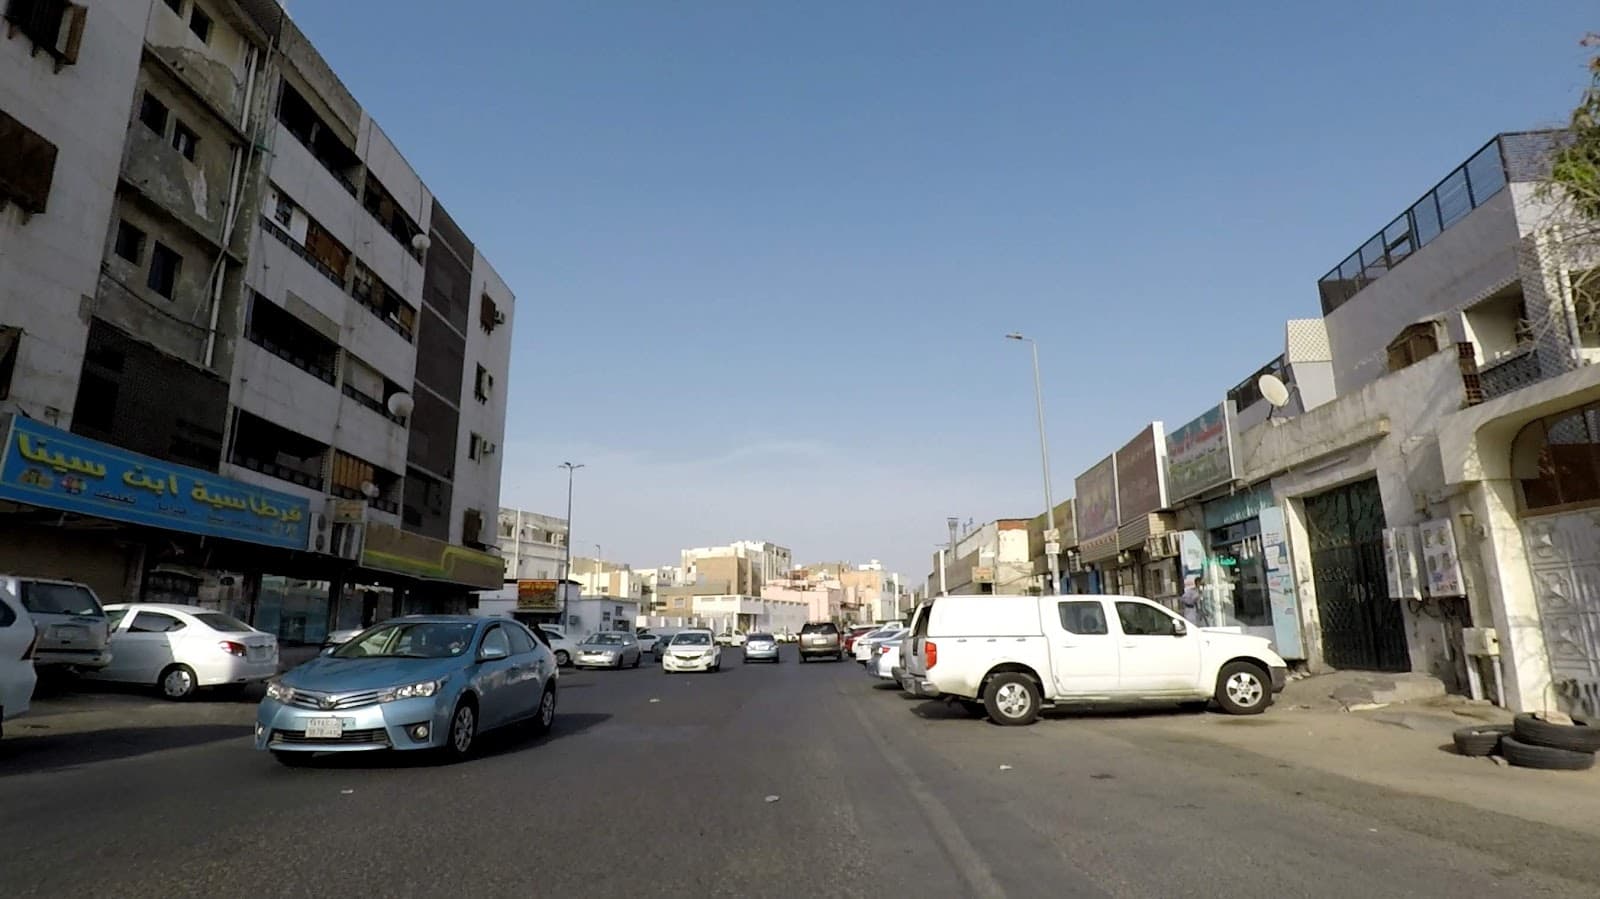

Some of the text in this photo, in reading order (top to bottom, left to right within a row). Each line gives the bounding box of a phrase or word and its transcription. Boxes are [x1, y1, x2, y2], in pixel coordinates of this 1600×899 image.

[17, 432, 302, 522] قرطاسية ابن سينا
